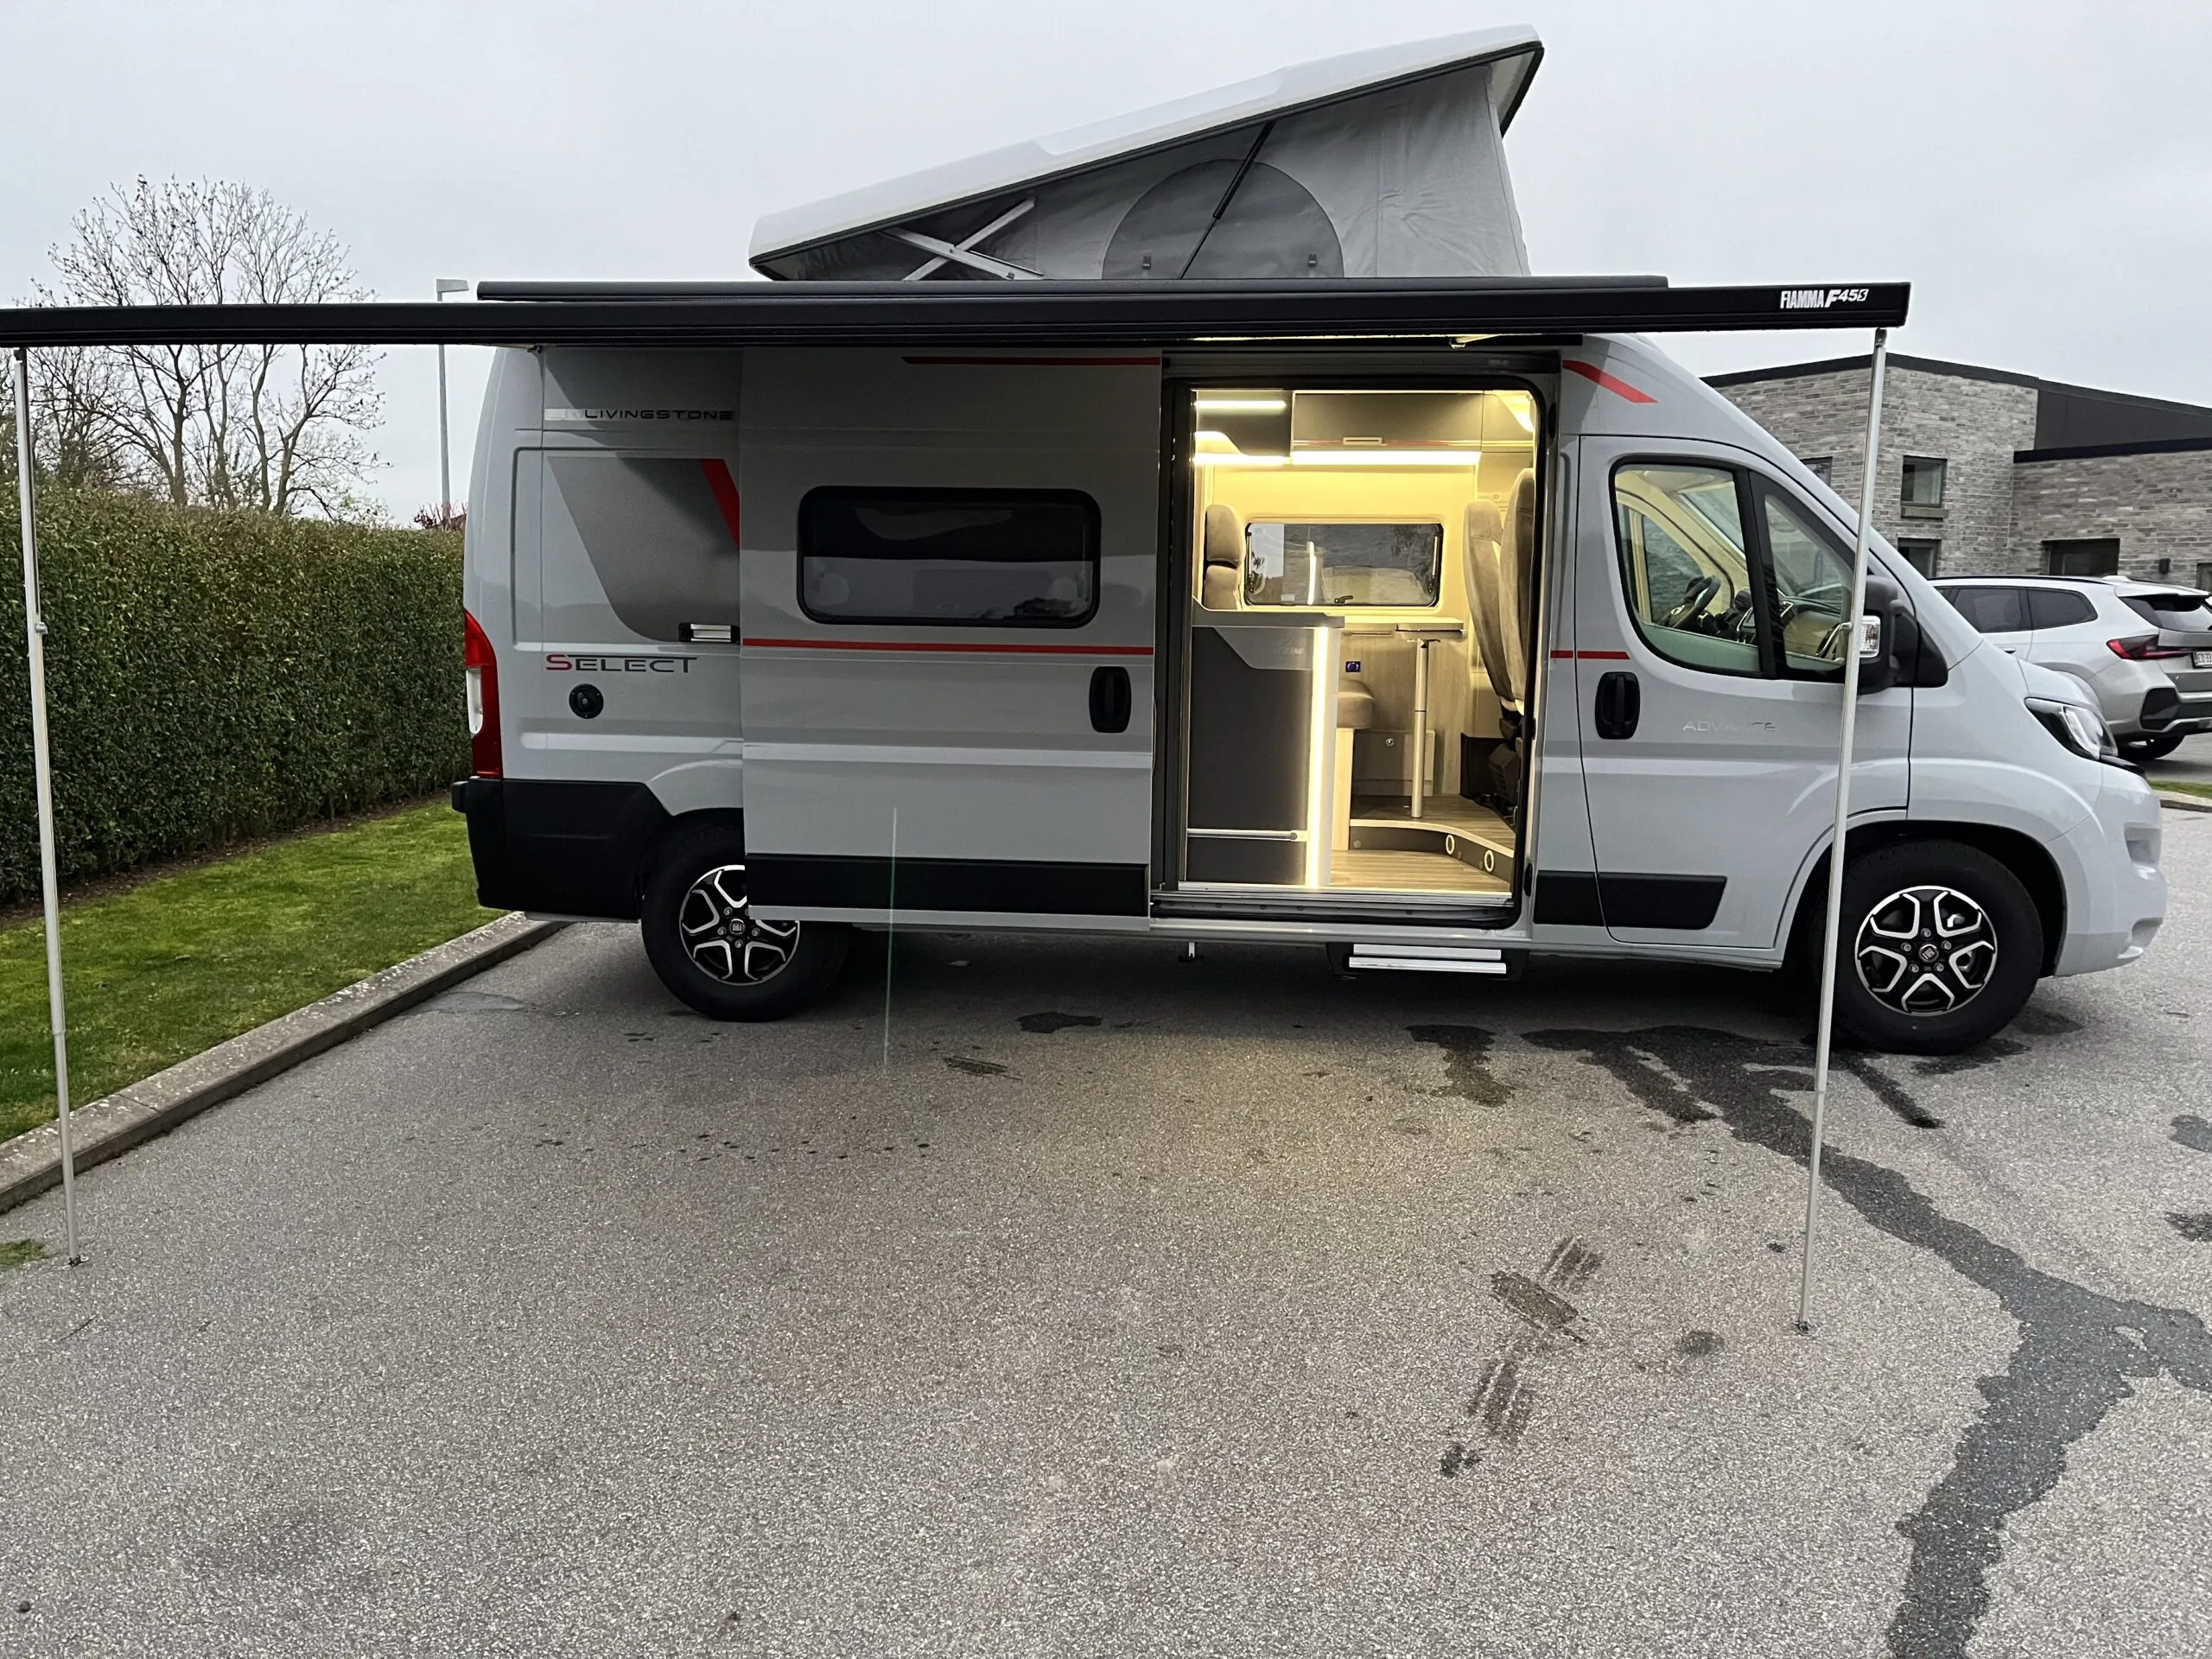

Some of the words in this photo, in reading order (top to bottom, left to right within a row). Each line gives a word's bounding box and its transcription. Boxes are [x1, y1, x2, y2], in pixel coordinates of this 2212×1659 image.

[1780, 289, 1824, 309] FIAMMA
[584, 409, 734, 421] LIVINGSTONE
[545, 653, 697, 674] SELECT
[1682, 720, 1777, 733] ADVACE
